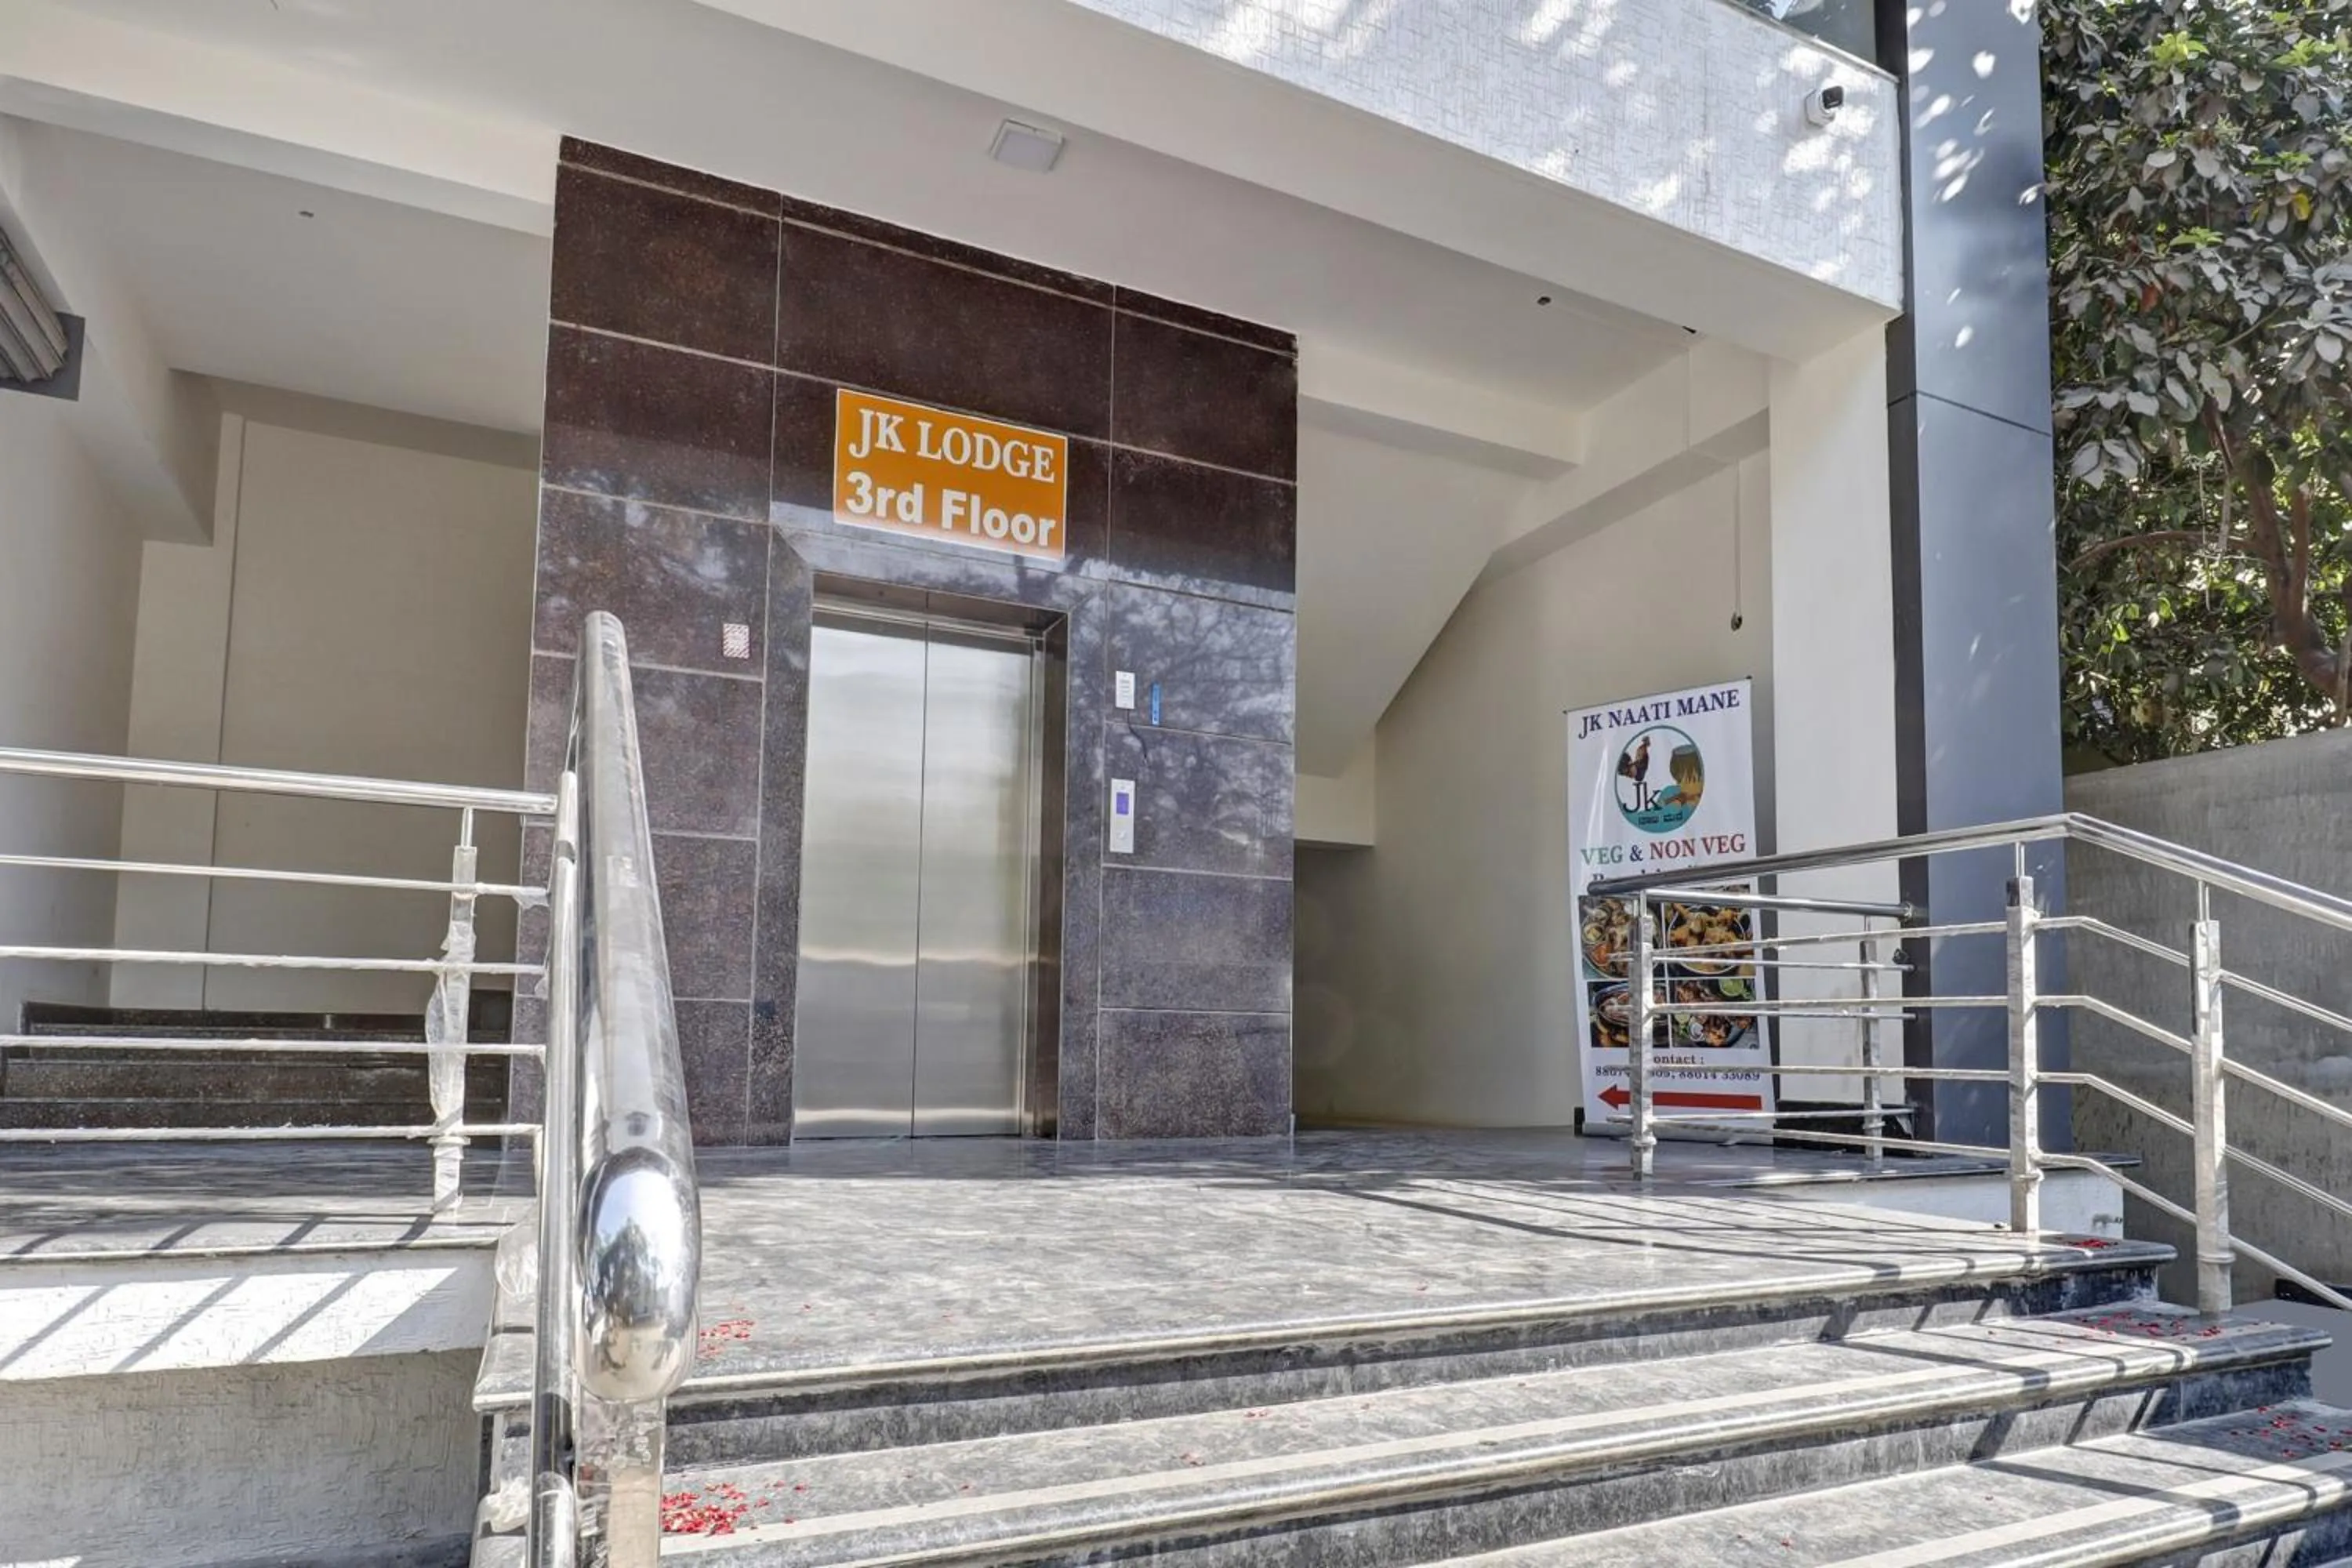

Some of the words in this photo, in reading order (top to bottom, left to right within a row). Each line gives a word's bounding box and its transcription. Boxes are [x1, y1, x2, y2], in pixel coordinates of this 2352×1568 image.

[848, 408, 906, 458] JK
[916, 421, 1054, 483] LODGE
[846, 471, 924, 524] 3rd
[942, 488, 1056, 546] Floor
[1578, 714, 1603, 739] JK
[1608, 701, 1671, 728] NAATI
[1677, 689, 1740, 716] MANE
[1581, 845, 1623, 865] VEG
[1629, 844, 1644, 862] &
[1650, 839, 1695, 860] NON
[1701, 834, 1745, 855] VEG
[1652, 1053, 1697, 1065] ontact
